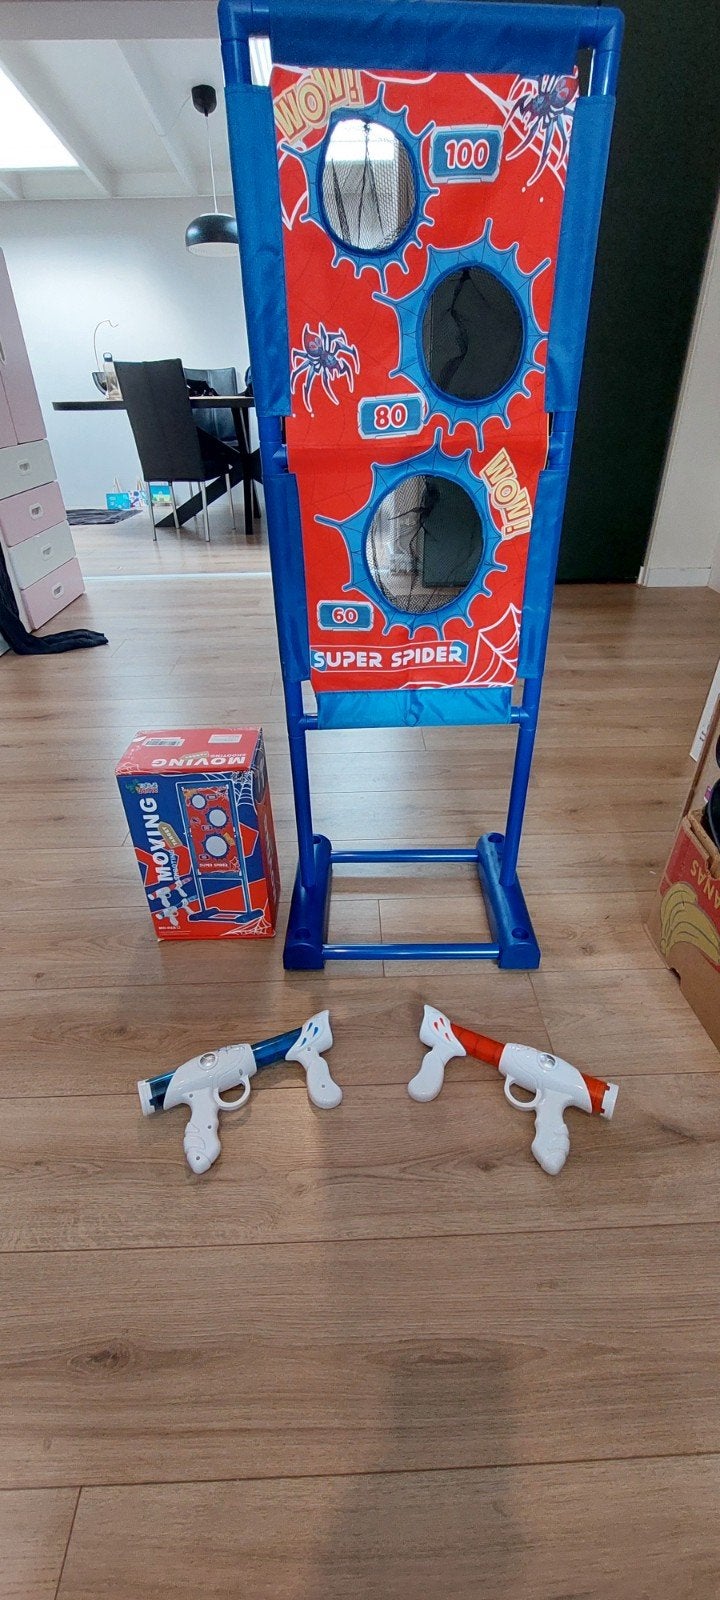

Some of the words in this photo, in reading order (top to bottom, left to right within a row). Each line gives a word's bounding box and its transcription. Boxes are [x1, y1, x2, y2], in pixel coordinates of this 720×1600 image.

[274, 68, 363, 142] WOW!
[444, 138, 490, 169] 100
[373, 404, 408, 430] 80
[481, 449, 532, 539] WOW!
[331, 607, 359, 624] 60
[313, 651, 384, 669] SUPER
[391, 645, 464, 668] SPIDER
[152, 756, 246, 767] MOVING
[140, 801, 171, 881] MOVING
